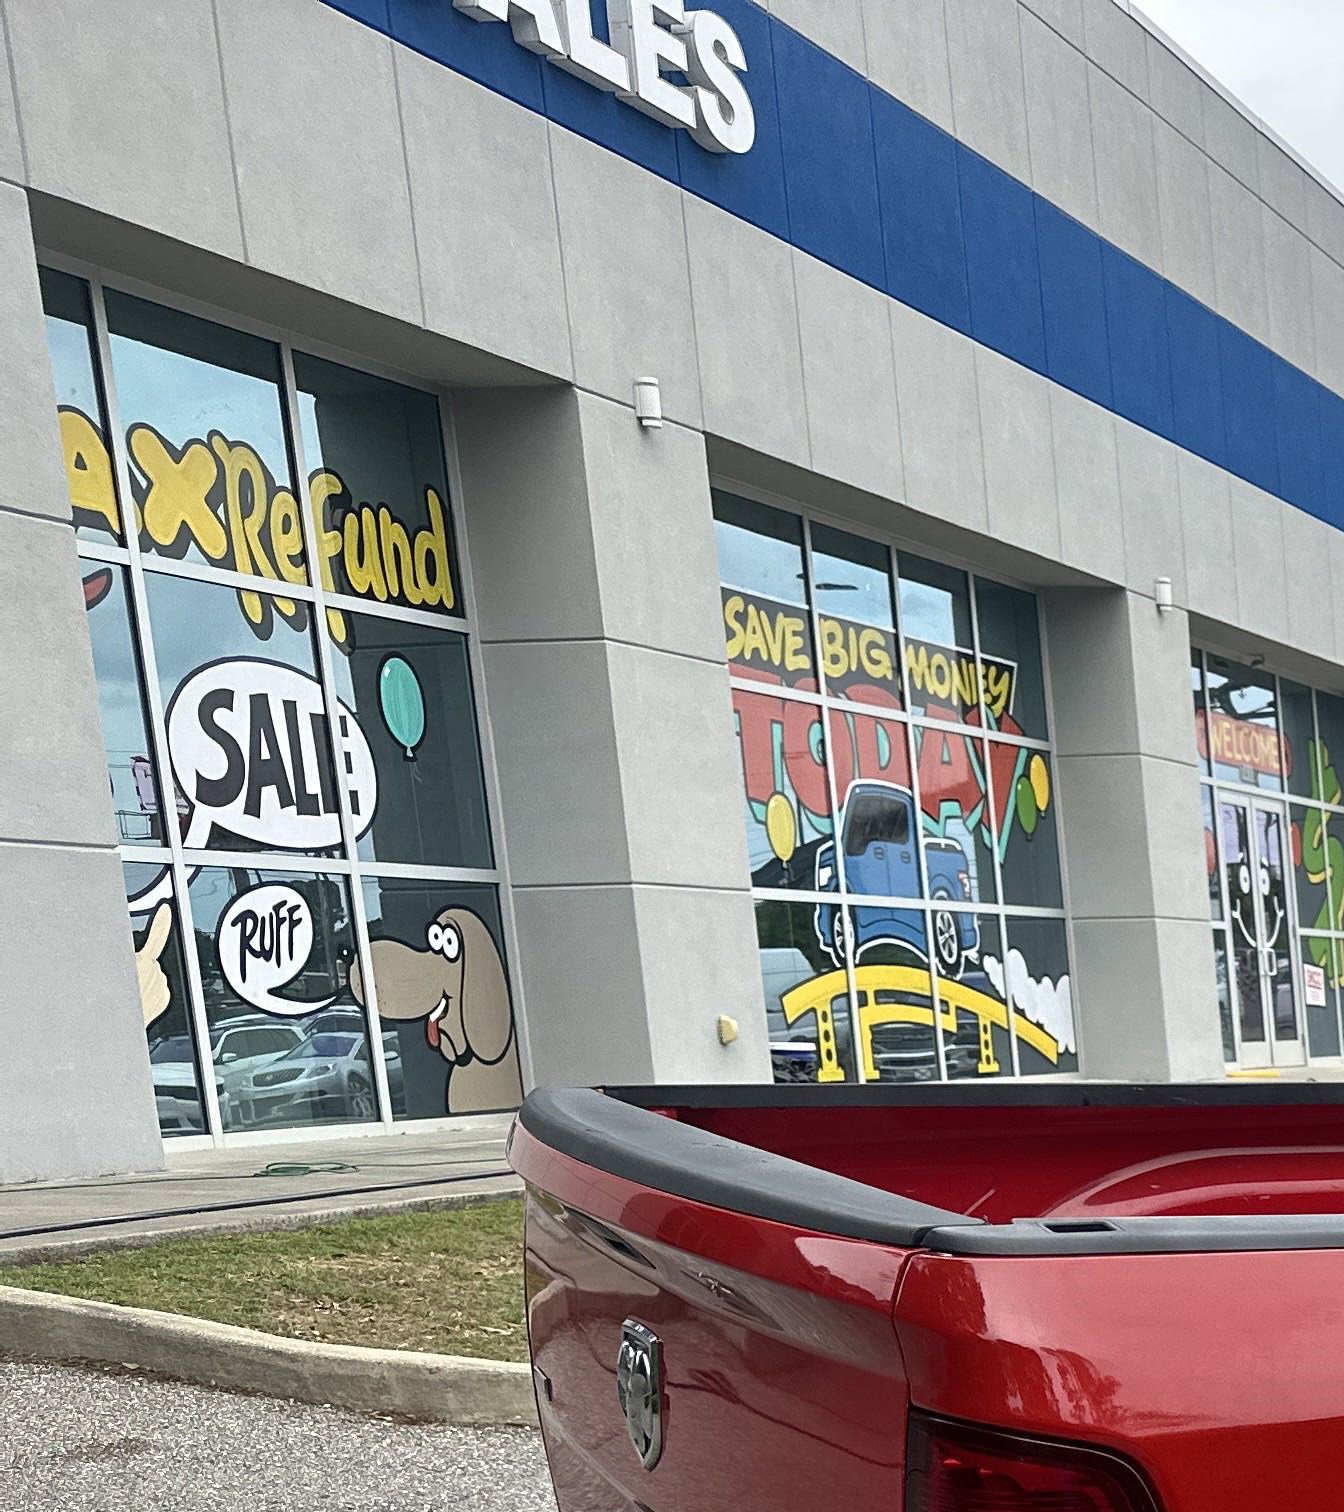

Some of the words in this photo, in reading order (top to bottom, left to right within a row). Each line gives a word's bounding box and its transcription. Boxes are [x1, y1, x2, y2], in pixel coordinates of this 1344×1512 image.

[723, 595, 811, 671] SAVE
[818, 617, 893, 680] BIG
[903, 643, 1010, 718] MONEY
[194, 688, 362, 818] SALE
[728, 662, 1026, 848] TODAY
[1211, 720, 1280, 770] WELCOME
[231, 899, 303, 983] RUFF
